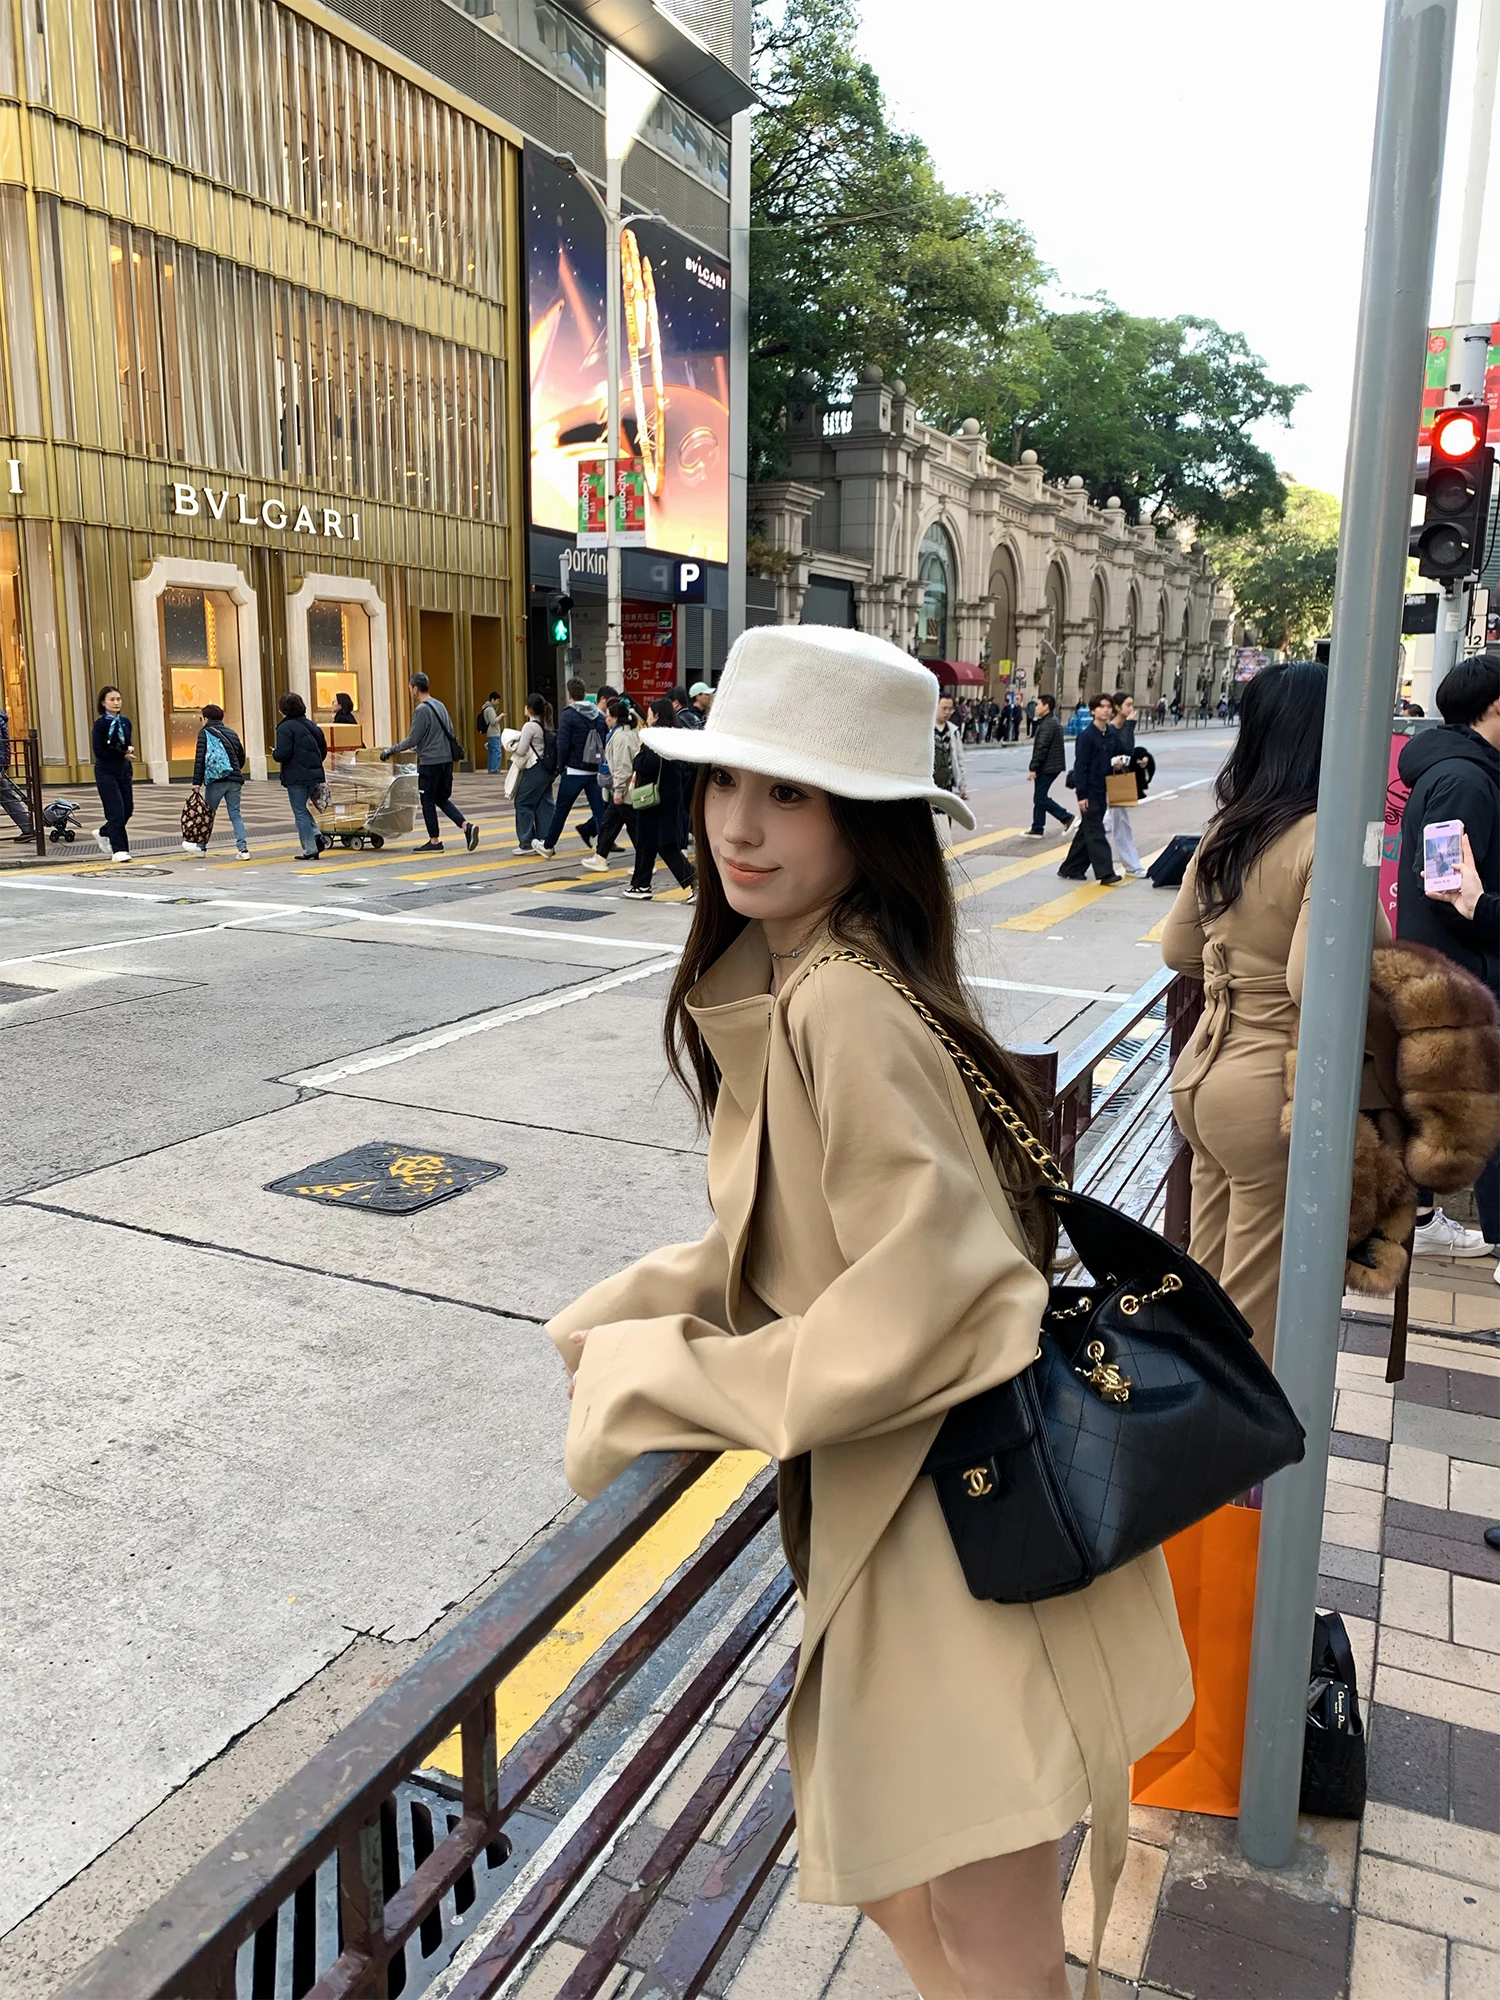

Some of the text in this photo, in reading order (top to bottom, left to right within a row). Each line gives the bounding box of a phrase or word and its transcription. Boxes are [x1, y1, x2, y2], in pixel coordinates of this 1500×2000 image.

[685, 257, 726, 290] BVLGARI
[171, 482, 361, 541] BVLGARI
[580, 472, 592, 520] curiocity
[617, 470, 629, 519] curiocity
[680, 563, 700, 592] P
[1468, 635, 1482, 646] 12
